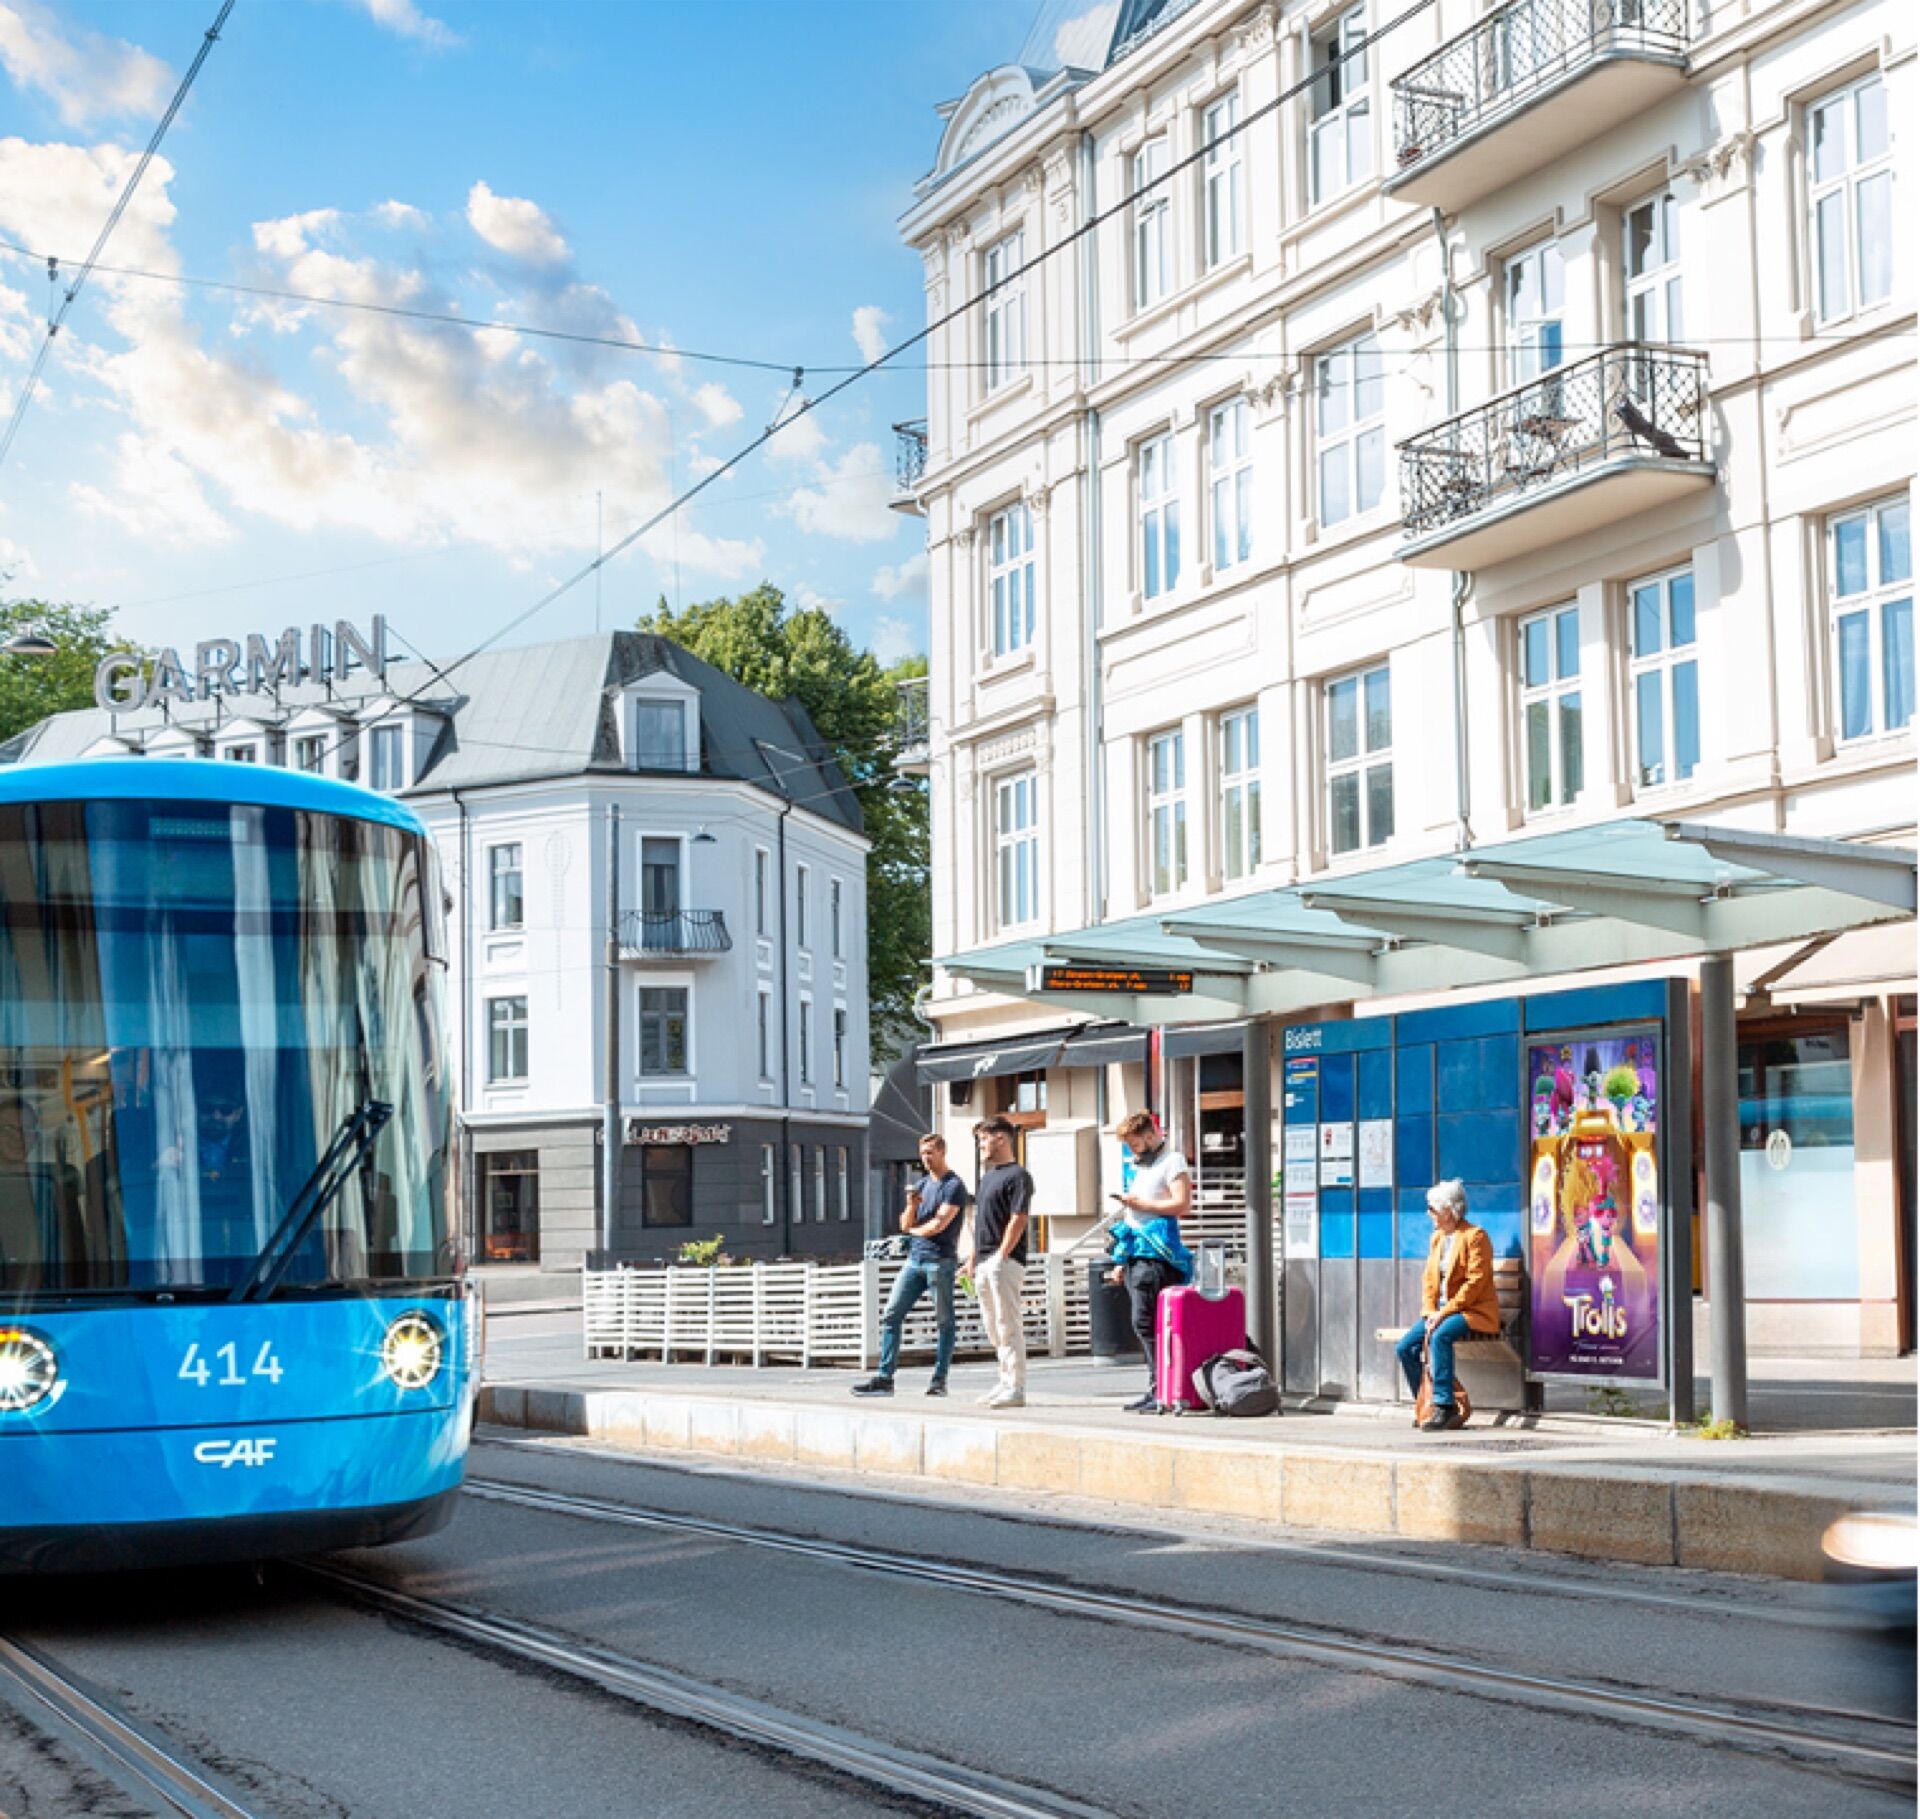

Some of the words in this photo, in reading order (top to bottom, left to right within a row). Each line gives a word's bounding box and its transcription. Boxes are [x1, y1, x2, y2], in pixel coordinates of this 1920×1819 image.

[95, 613, 386, 714] GARMIN
[1284, 1028, 1322, 1051] Bislett
[1560, 1293, 1628, 1339] Trolls
[178, 1340, 284, 1387] 414
[193, 1437, 277, 1469] CAF
